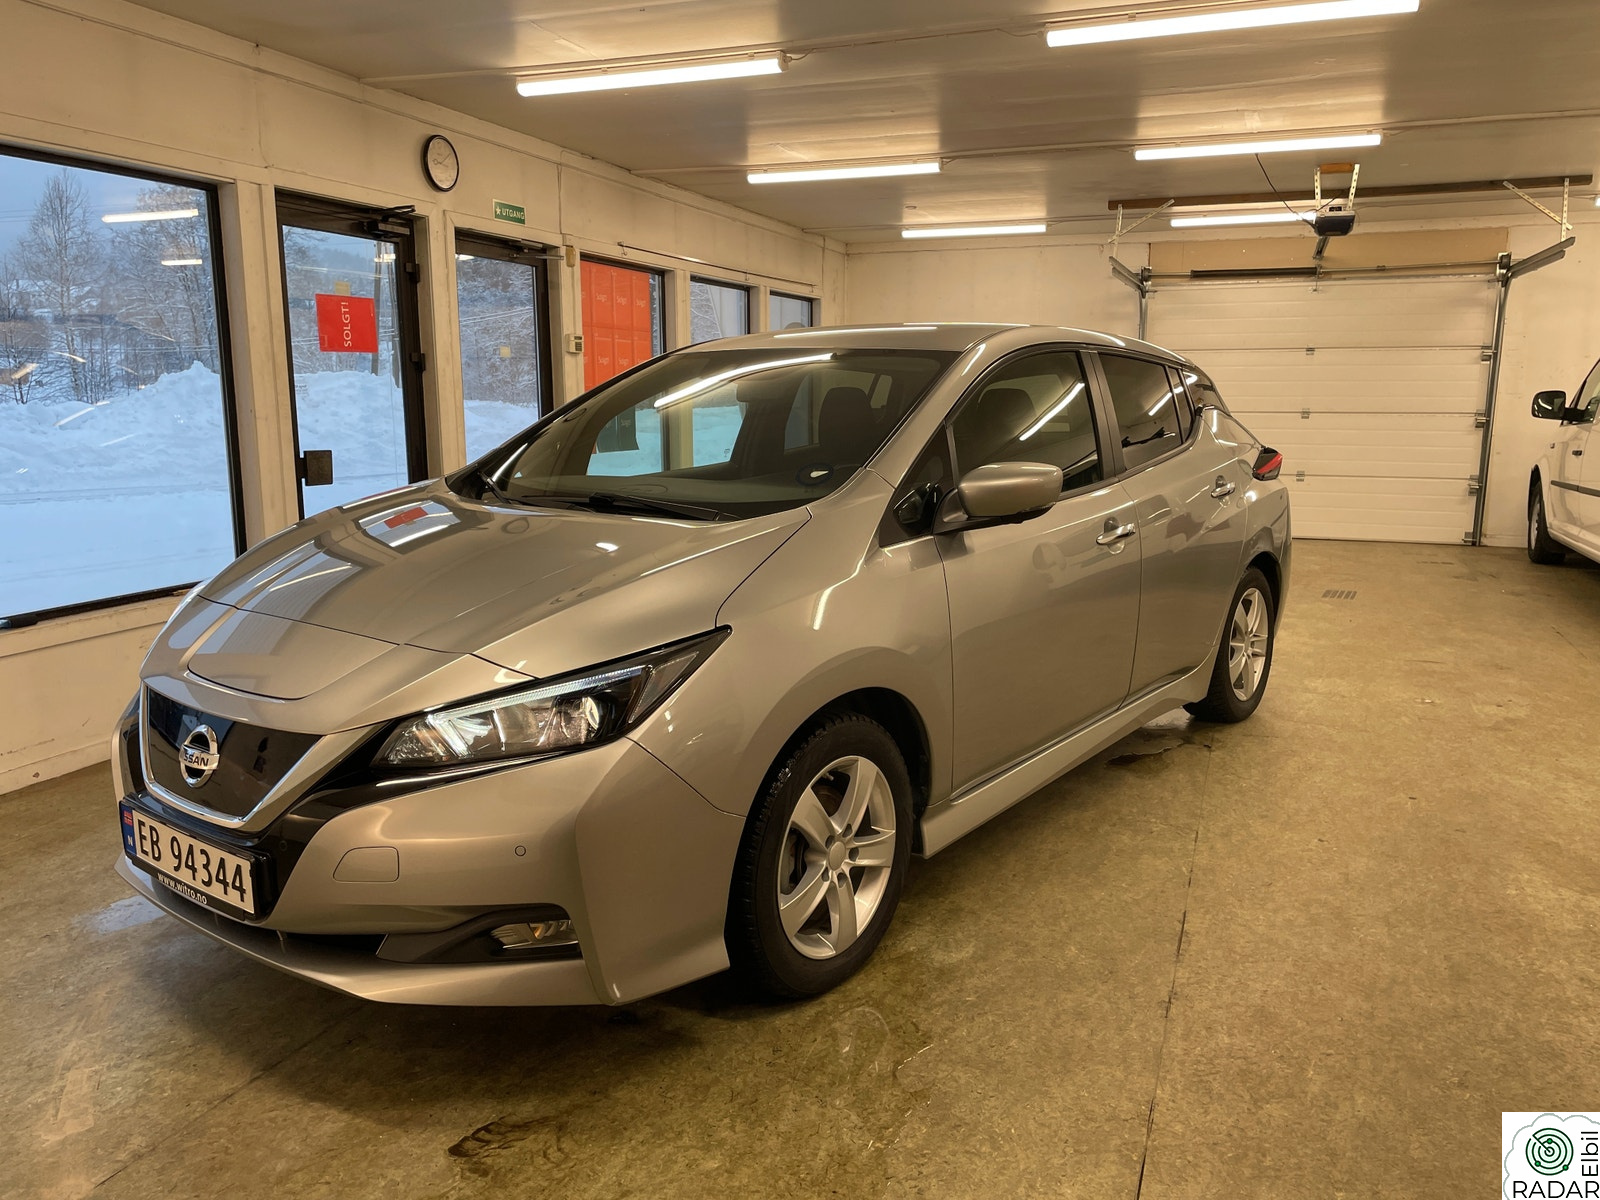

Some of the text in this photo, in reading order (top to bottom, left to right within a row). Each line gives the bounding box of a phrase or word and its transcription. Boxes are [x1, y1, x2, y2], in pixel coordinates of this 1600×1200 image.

[501, 207, 525, 220] UTGANG
[340, 301, 352, 348] SOLGT!
[127, 835, 134, 847] N
[137, 818, 247, 903] EB 94344
[157, 872, 208, 906] www.witro.no
